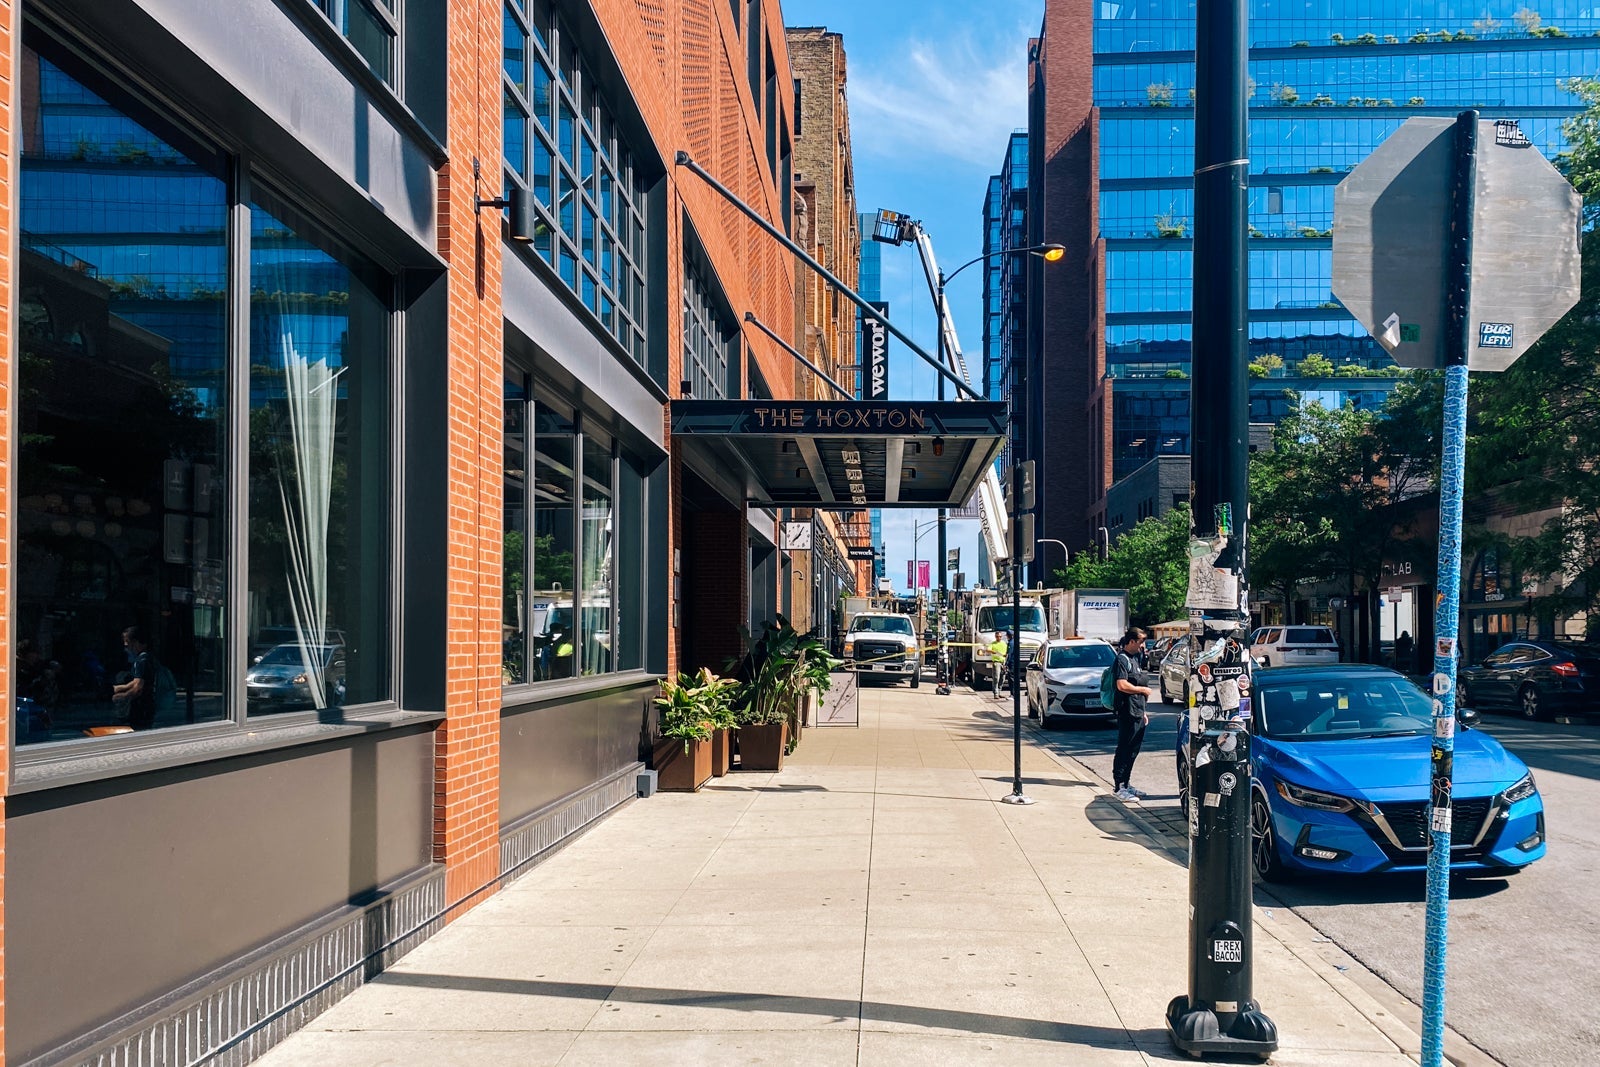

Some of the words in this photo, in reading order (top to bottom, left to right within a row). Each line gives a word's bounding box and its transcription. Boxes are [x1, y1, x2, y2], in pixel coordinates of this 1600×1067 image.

[1483, 335, 1511, 345] LEFTY
[865, 307, 885, 397] wework
[754, 408, 805, 427] THE
[816, 408, 925, 429] HOXTON
[1214, 667, 1242, 675] muros
[1215, 941, 1241, 951] T-REX
[1215, 951, 1241, 961] BACON
